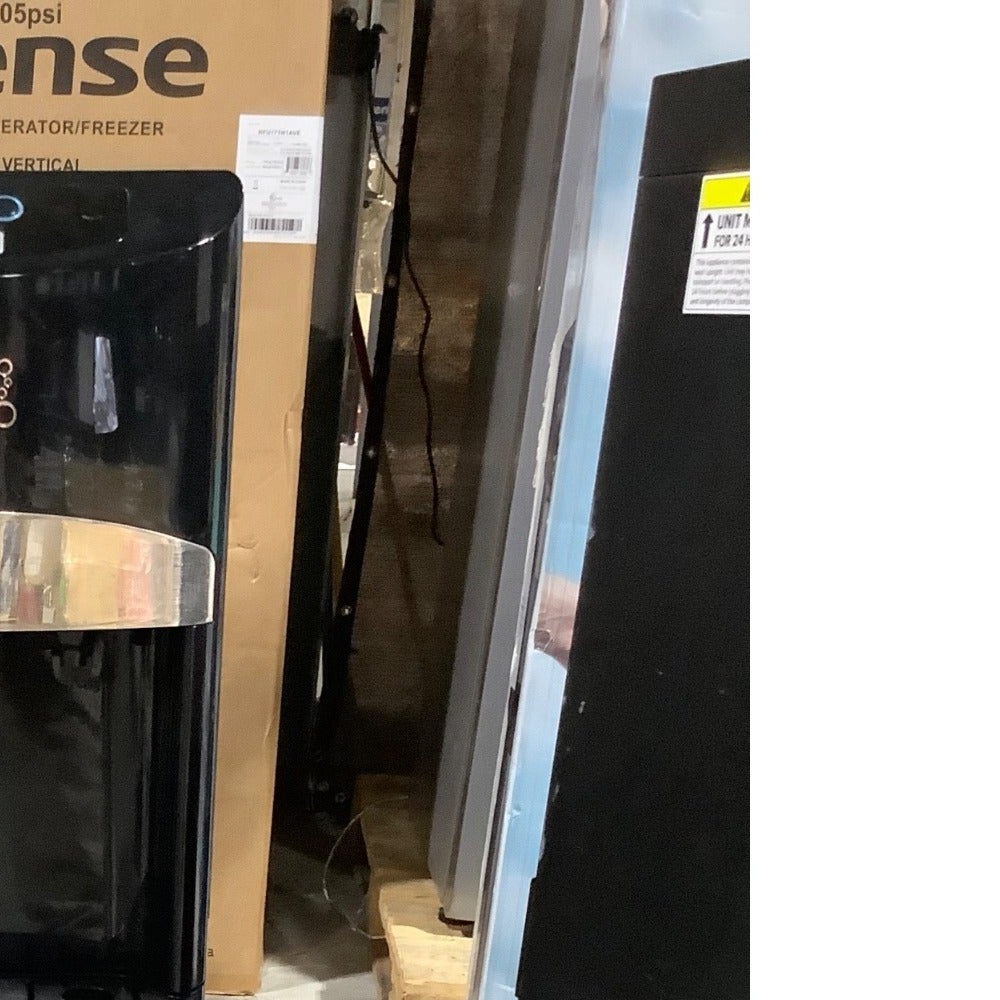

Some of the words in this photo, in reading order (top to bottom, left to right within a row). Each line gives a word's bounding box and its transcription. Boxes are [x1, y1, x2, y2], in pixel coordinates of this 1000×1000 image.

[717, 213, 742, 229] UNIT
[714, 235, 731, 248] FOR
[732, 234, 744, 246] 24
